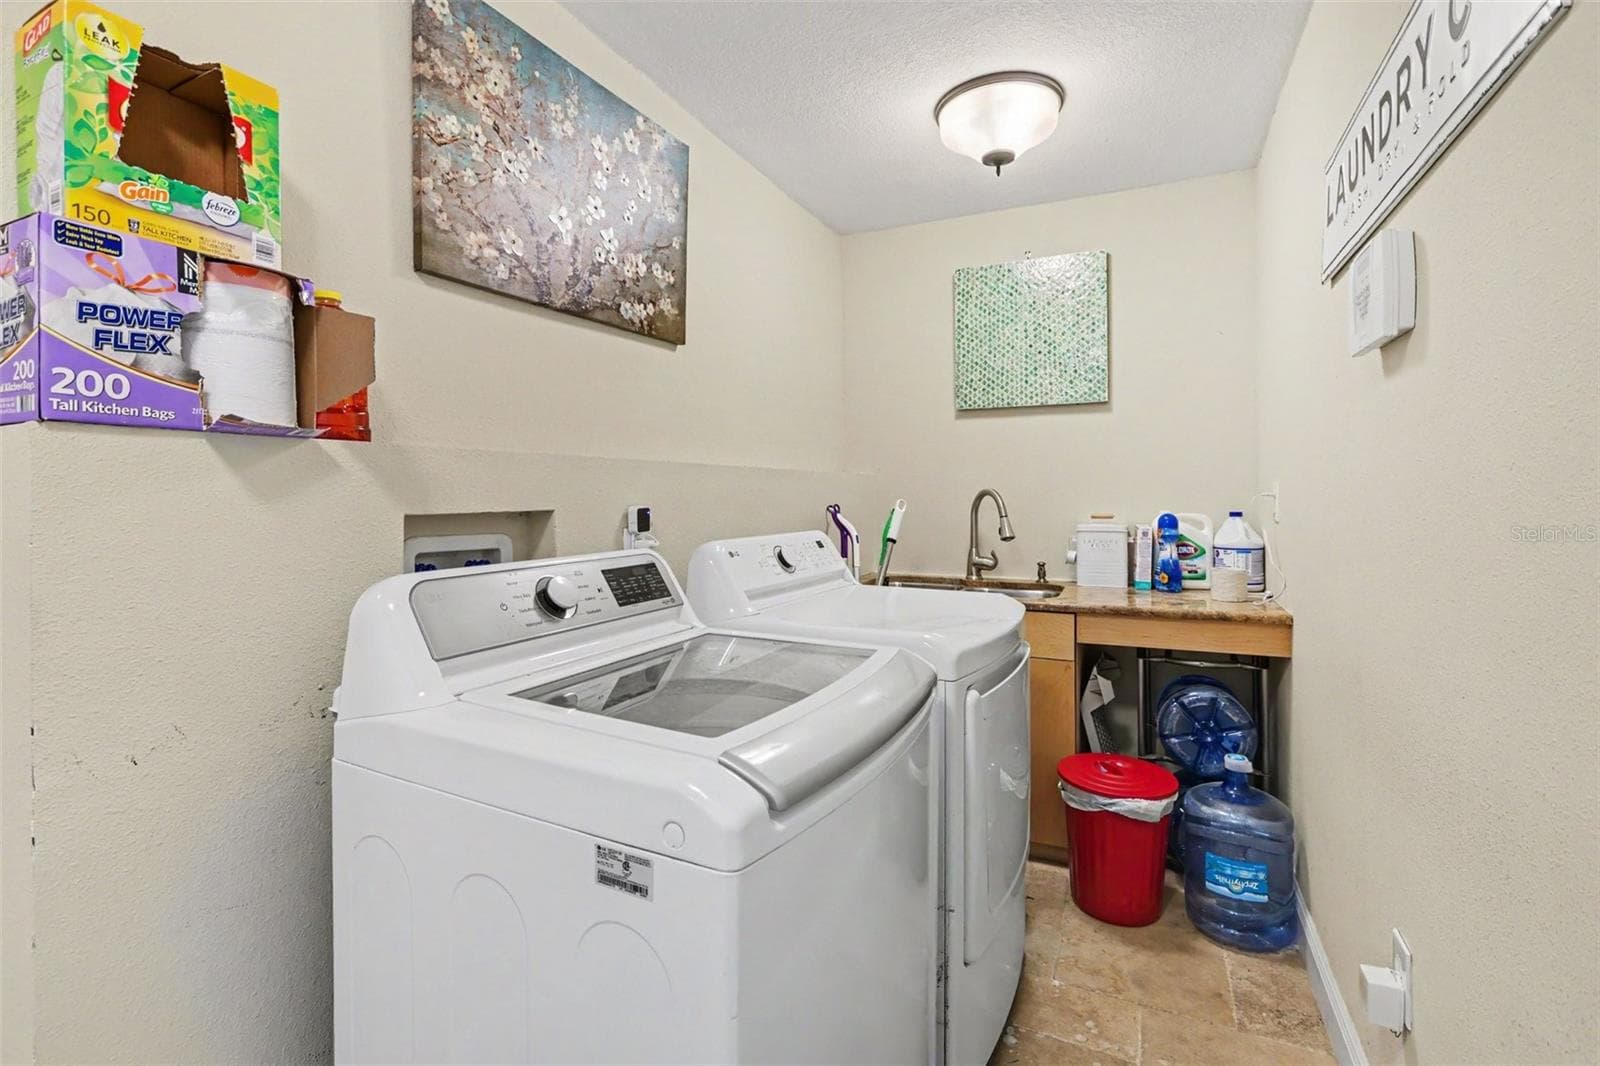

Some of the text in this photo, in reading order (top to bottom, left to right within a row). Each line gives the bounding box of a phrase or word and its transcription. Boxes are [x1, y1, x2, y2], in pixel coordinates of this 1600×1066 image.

[24, 14, 51, 52] GLAD
[84, 27, 120, 49] LEAK
[1427, 40, 1471, 115] FOLD
[1326, 11, 1434, 229] LAUNDRY
[119, 181, 169, 202] Gain
[71, 203, 111, 226] 150
[206, 200, 237, 216] febreze
[142, 225, 160, 237] TALL
[160, 229, 193, 244] KITCHEN
[76, 301, 184, 332] POWER
[93, 328, 174, 355] FLEX
[13, 359, 34, 380] 200
[51, 366, 131, 400] 200
[49, 397, 78, 412] Tall
[82, 398, 139, 417] Kitchen
[142, 405, 175, 420] Bags
